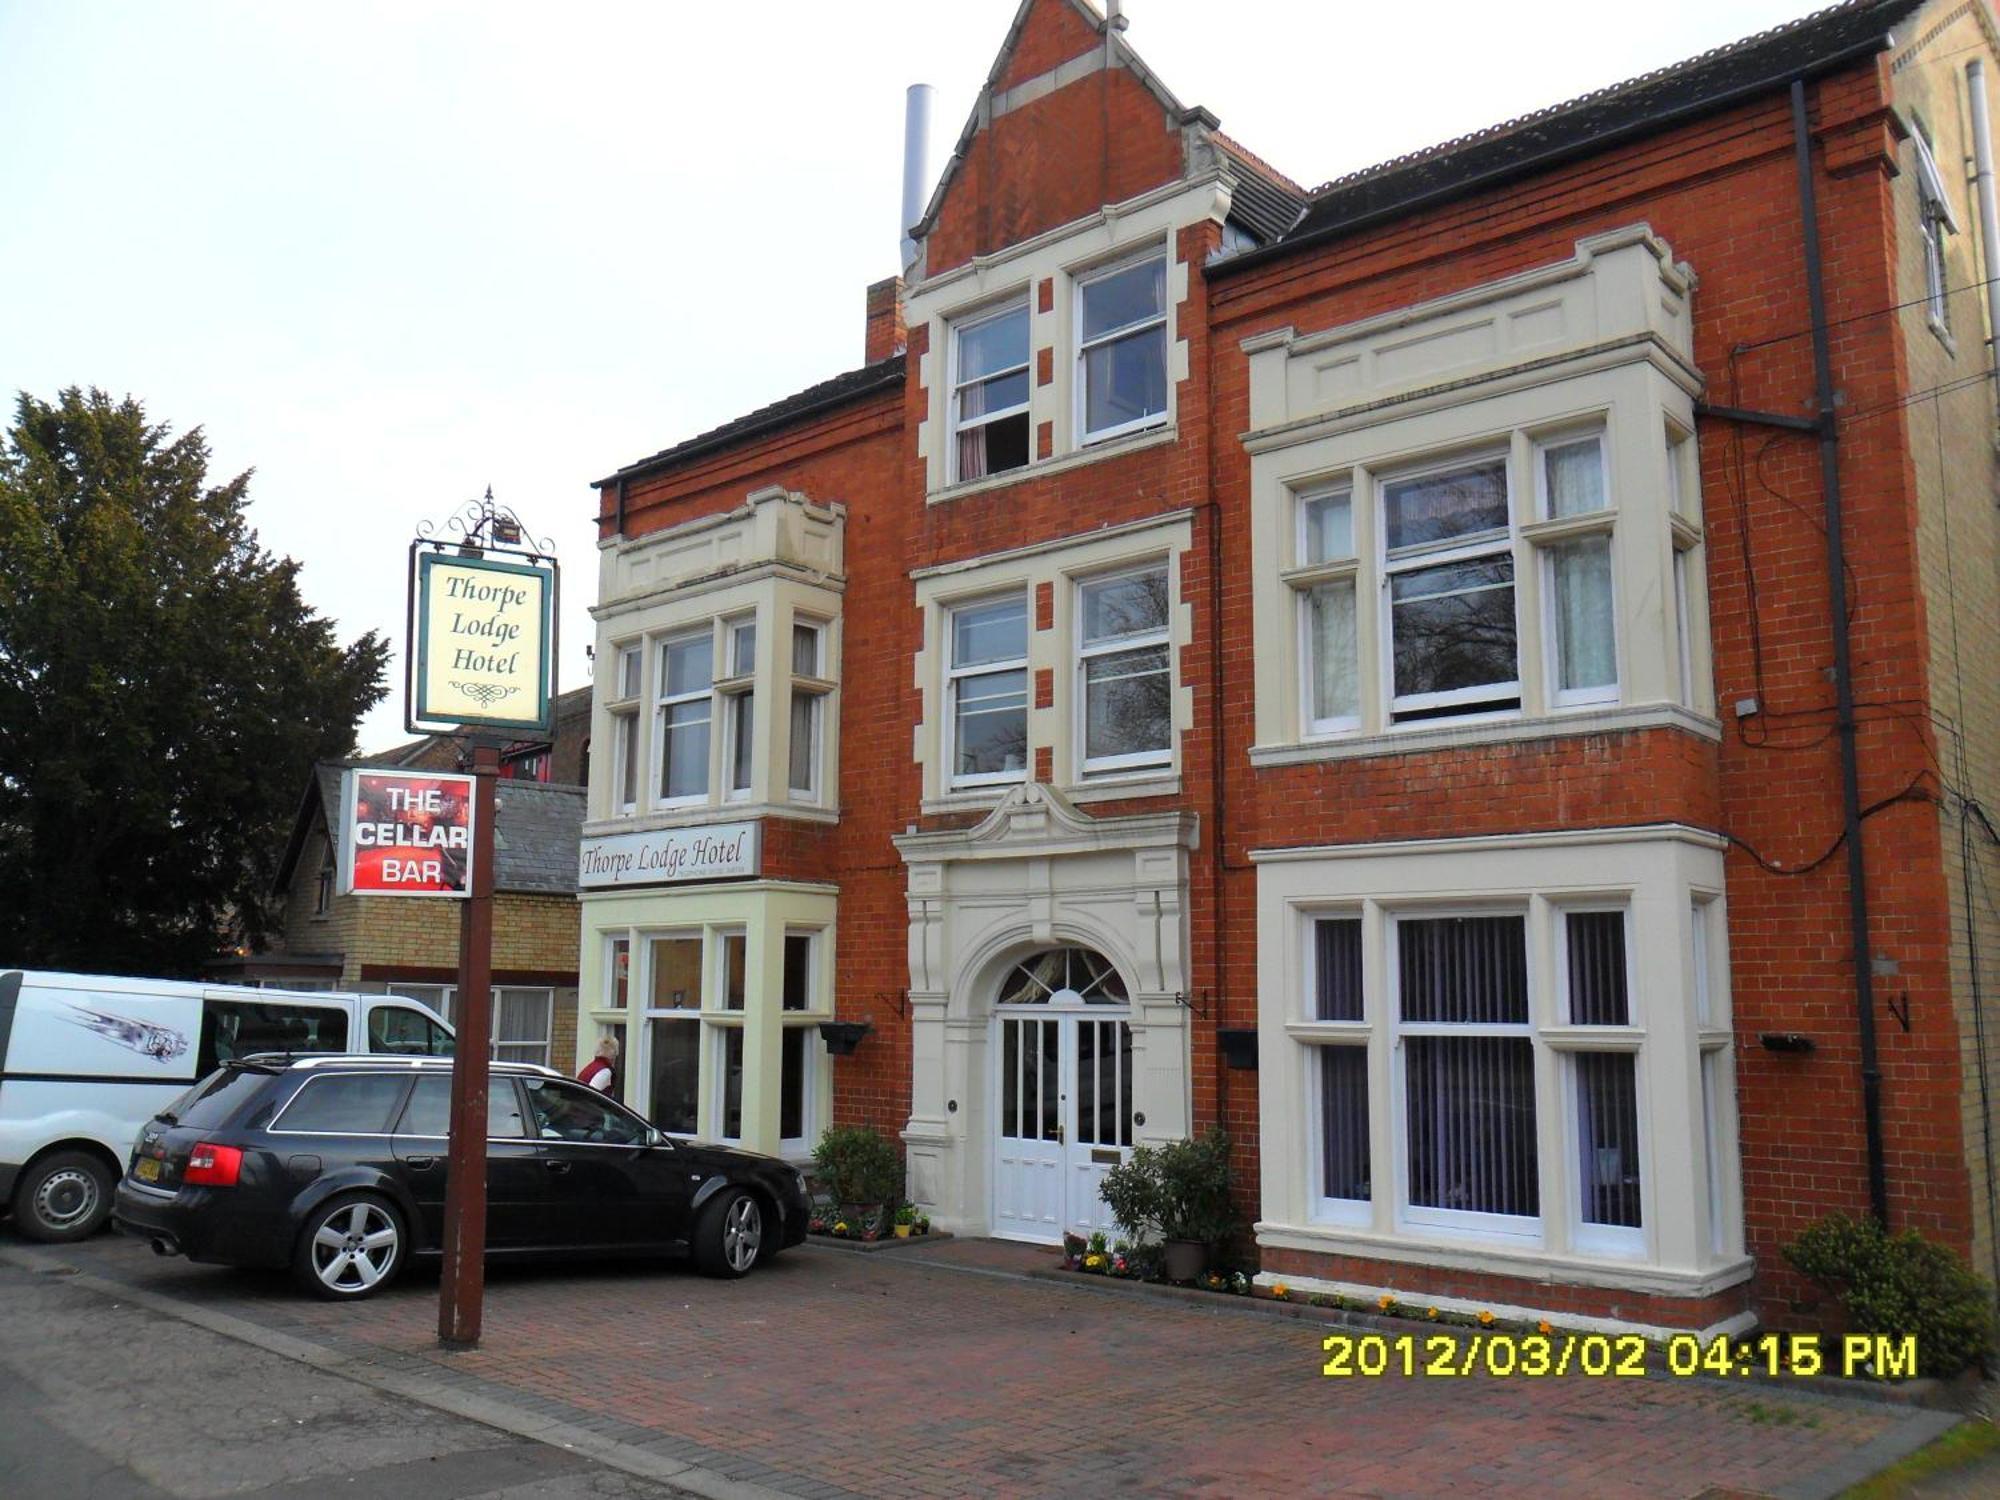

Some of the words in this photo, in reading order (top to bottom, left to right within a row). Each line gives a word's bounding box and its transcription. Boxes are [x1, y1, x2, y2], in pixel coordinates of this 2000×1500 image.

[446, 576, 527, 613] Thorpe
[450, 612, 520, 647] Lodge
[452, 647, 520, 675] Hotel
[386, 787, 442, 813] THE
[355, 822, 468, 849] CELLAR
[582, 845, 633, 881] Thorpe
[638, 838, 686, 877] Lodge
[691, 831, 746, 867] Hotel
[381, 859, 442, 884] BAR
